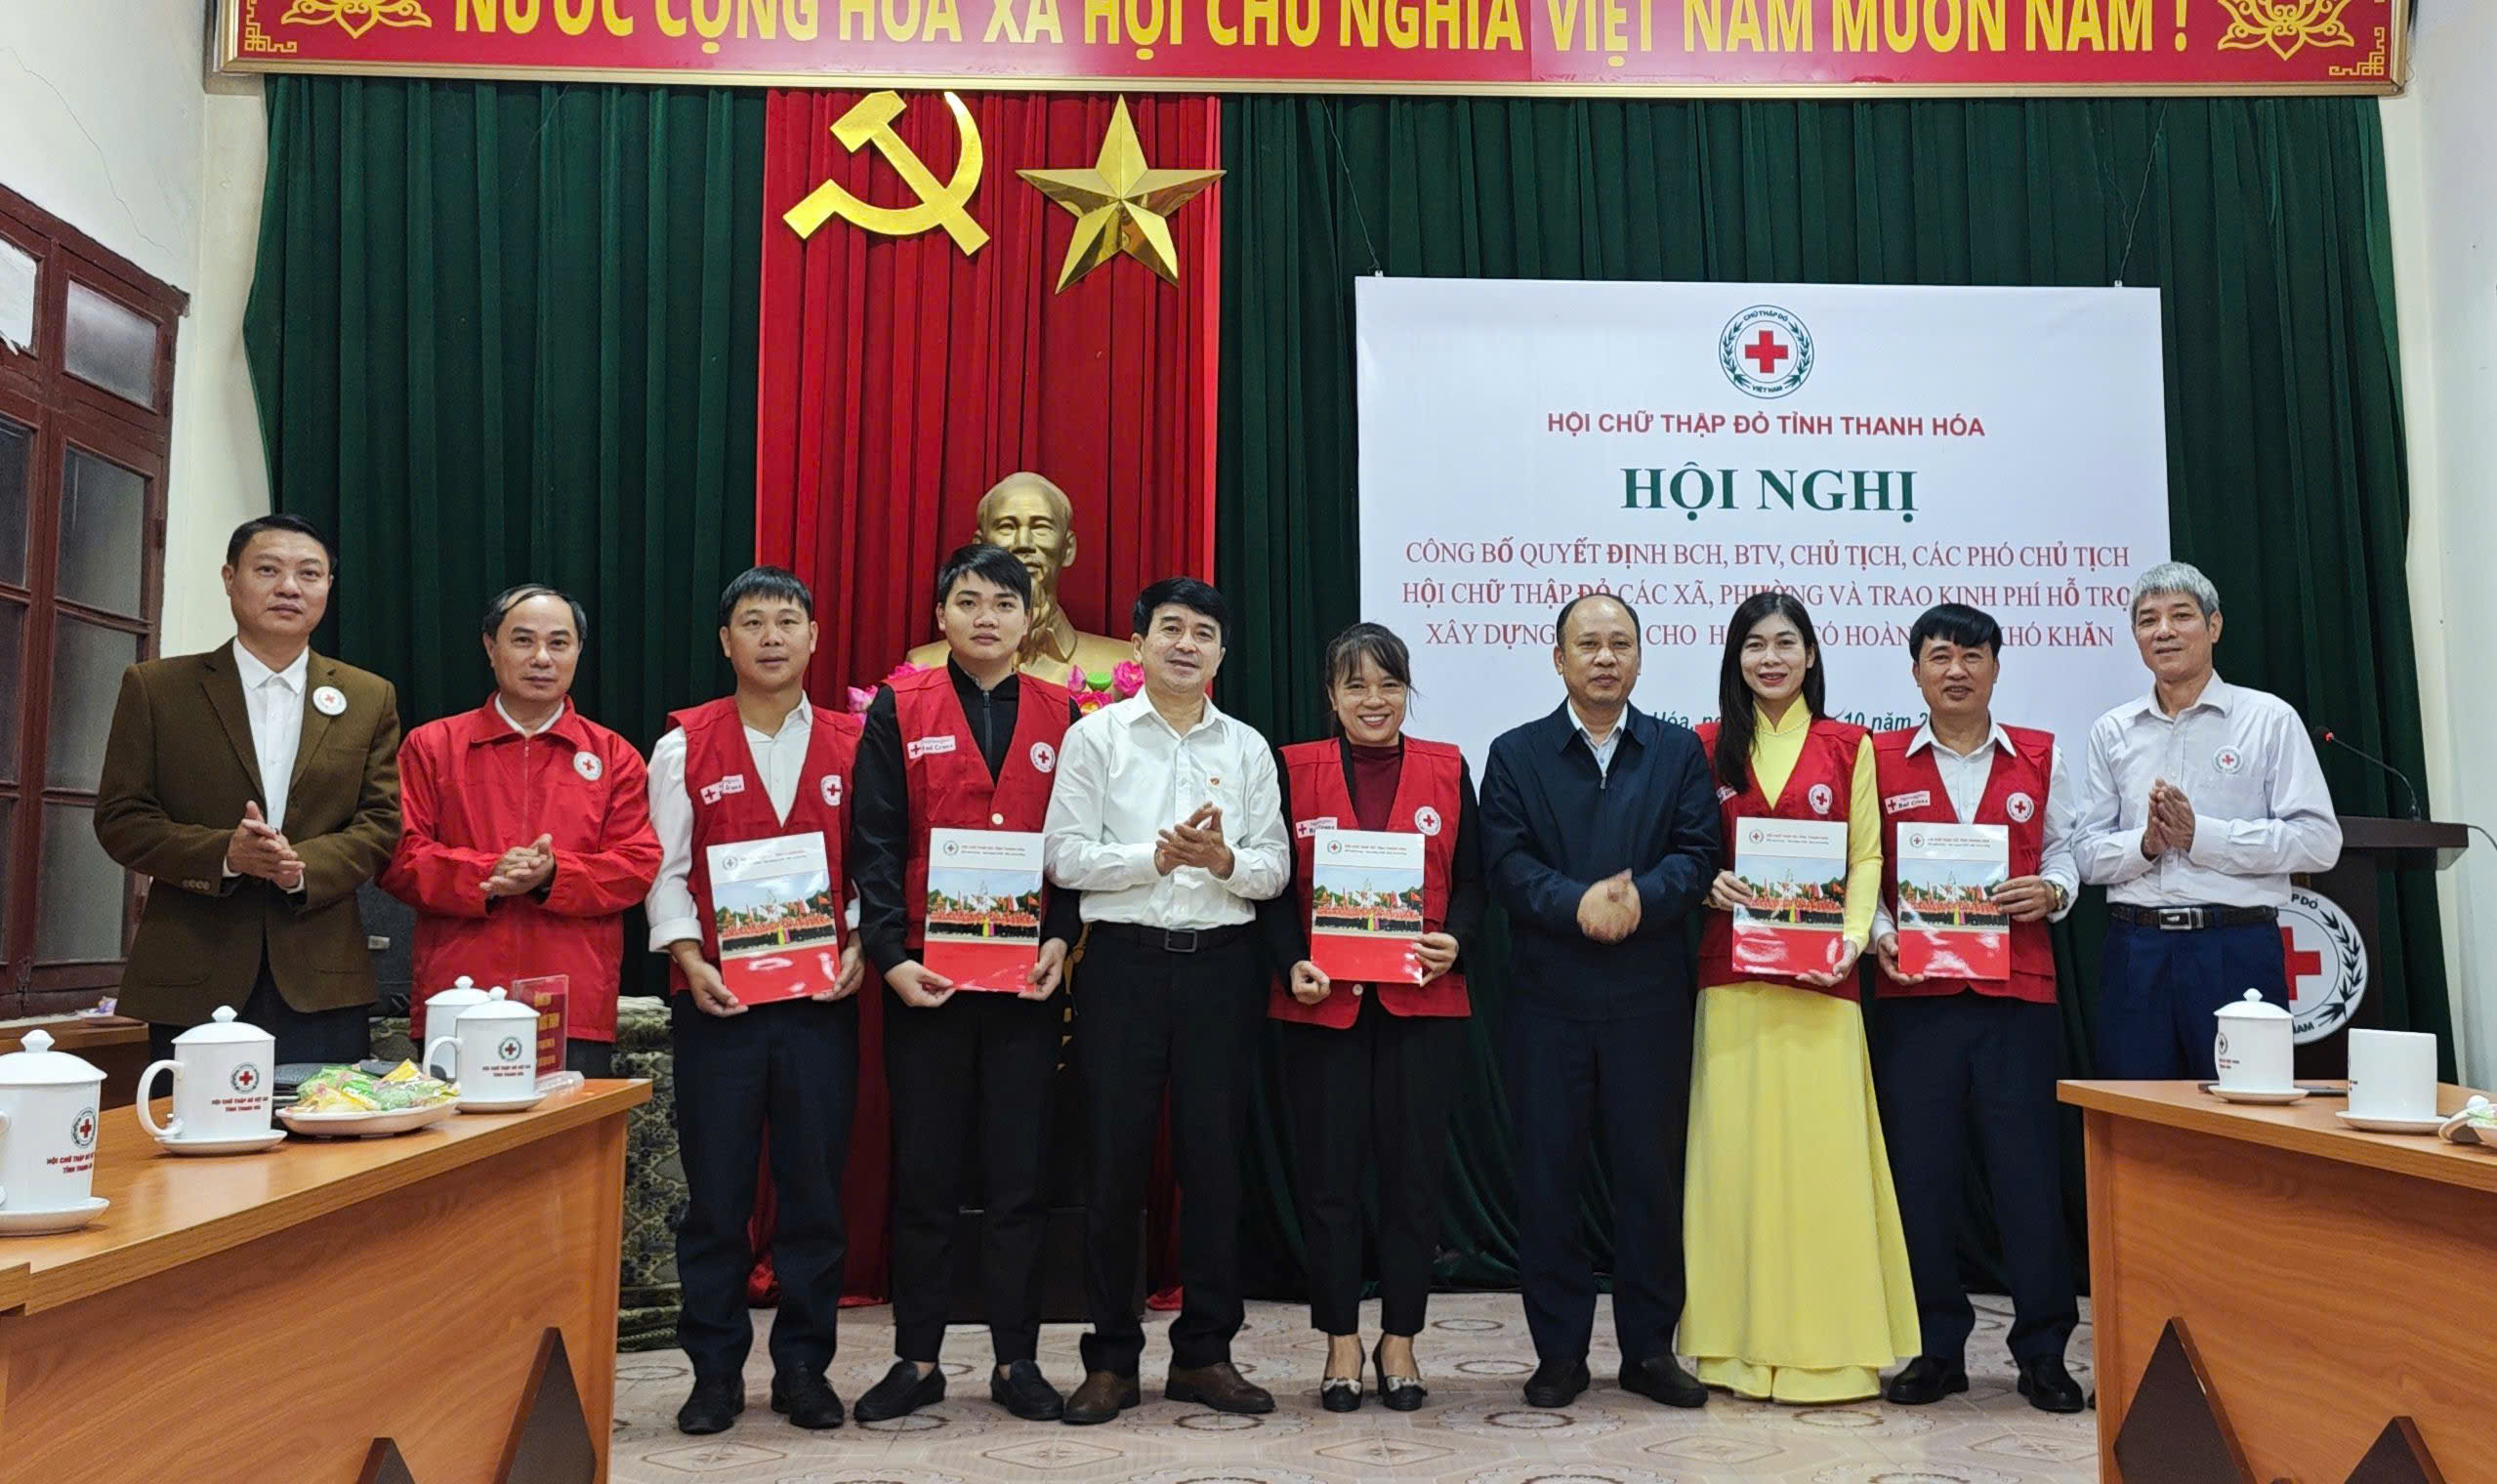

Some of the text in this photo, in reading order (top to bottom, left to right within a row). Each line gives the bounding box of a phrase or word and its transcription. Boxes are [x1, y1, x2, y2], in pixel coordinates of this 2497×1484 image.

[1684, 0, 1812, 52] NAM
[1547, 410, 1986, 437] HỘI CHỮ THẬP ĐỎ TỈNH THANH HÓA
[1619, 460, 1919, 523] HỘI NGHỊ
[1406, 536, 2130, 572] CÔNG BỐ QUYẾT ĐỊNH BCH, BTV, CHỦ TỊCH, CÁC PHÓ CHỦ TỊCH
[1401, 578, 1445, 608] HỘI
[1451, 579, 1506, 603] CHỮ
[1511, 578, 1572, 609] THẬP
[1617, 579, 1668, 604] CÁC
[1673, 579, 1715, 608] XÃ,
[1827, 580, 1863, 605] VÀ
[1868, 585, 1934, 606] TRAO
[1937, 586, 1998, 606] KINH
[2004, 581, 2040, 606] PHÍ
[2047, 577, 2080, 607] HỖ
[1426, 618, 1478, 644] XÂY
[1483, 623, 1556, 649] DỰNG
[1645, 623, 1696, 645] CHO
[2047, 621, 2114, 646] KHĂN
[1872, 712, 1911, 730] năm
